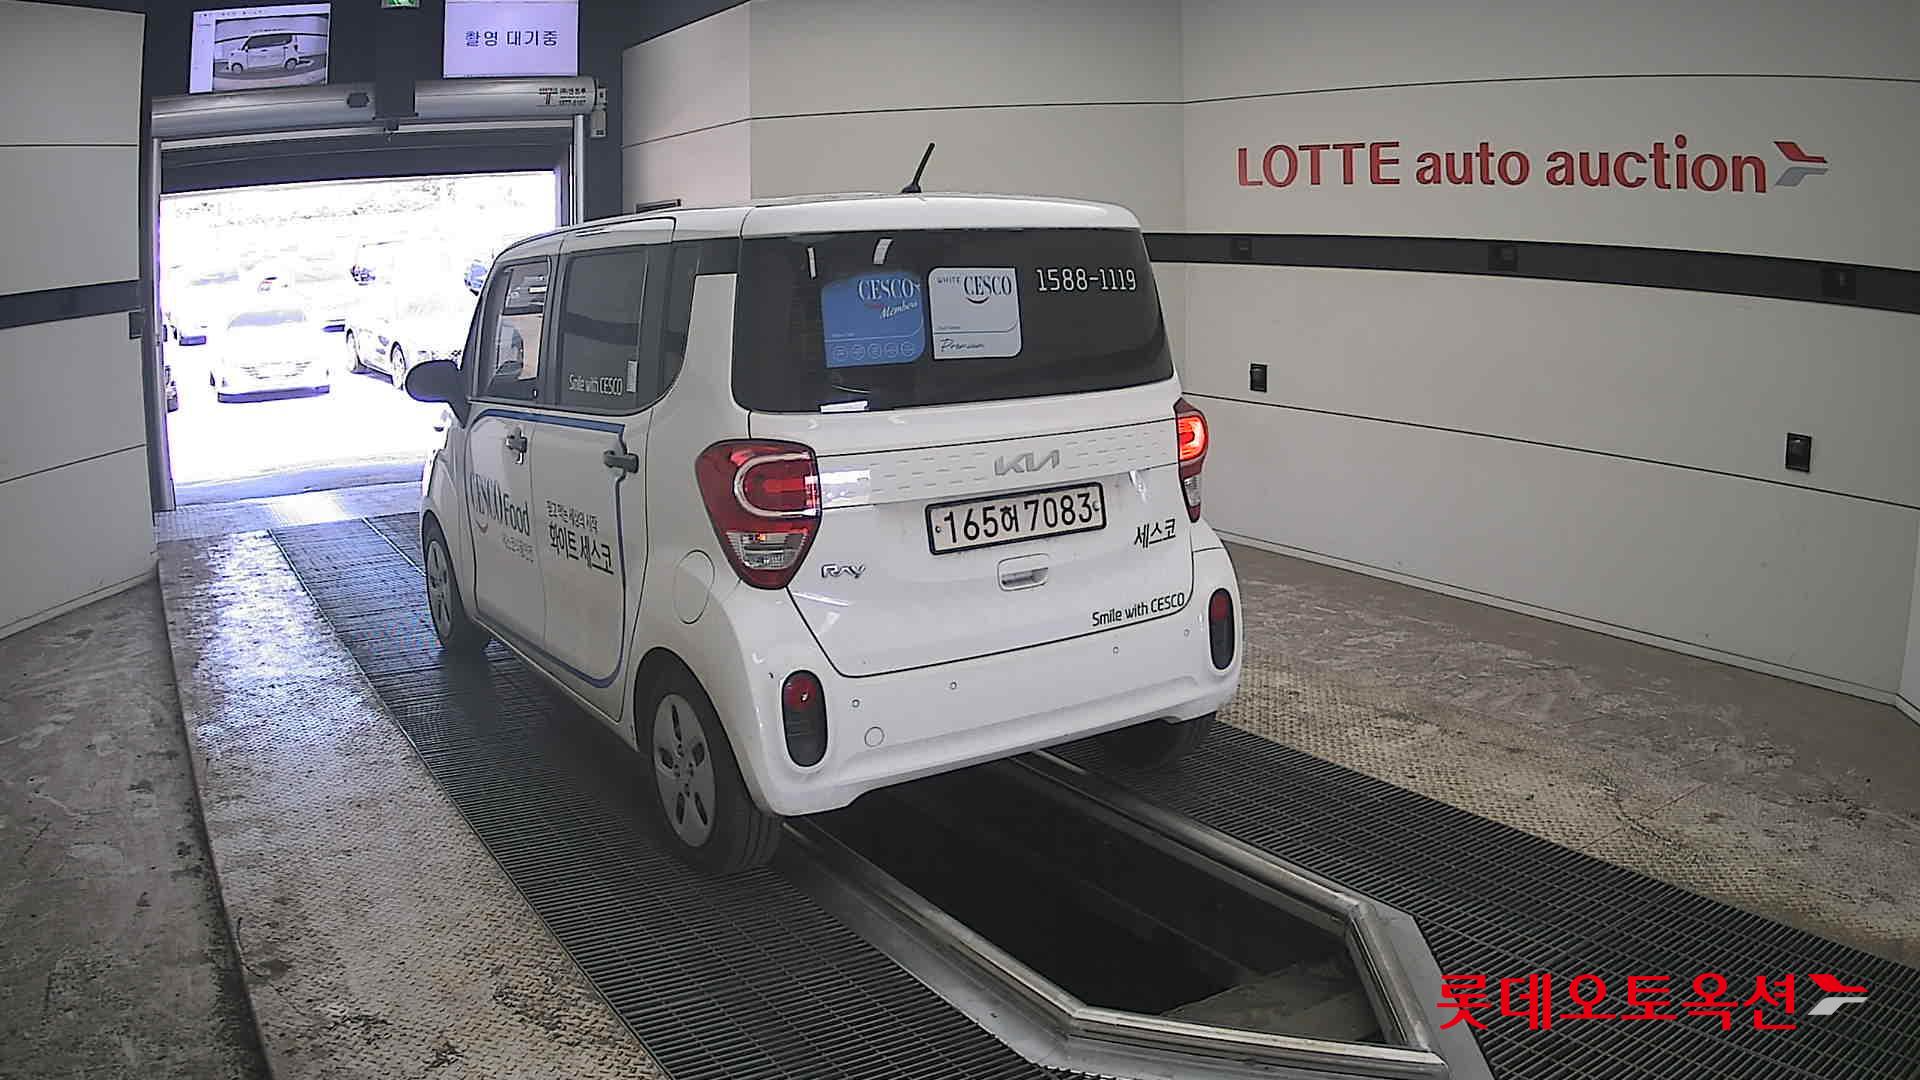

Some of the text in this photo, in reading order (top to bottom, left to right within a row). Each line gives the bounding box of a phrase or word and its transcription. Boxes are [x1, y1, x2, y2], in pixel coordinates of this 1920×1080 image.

[464, 30, 558, 47] 촬영 대기중
[1236, 133, 1768, 194] LOTTE auto auction
[856, 279, 915, 301] CESCO
[963, 275, 1012, 296] CESCO
[1036, 267, 1138, 293] 1588-1119
[503, 493, 530, 537] Food
[1134, 518, 1177, 549] 세스코
[580, 536, 614, 576] 세스코
[1092, 592, 1185, 627] Smile with CESCO
